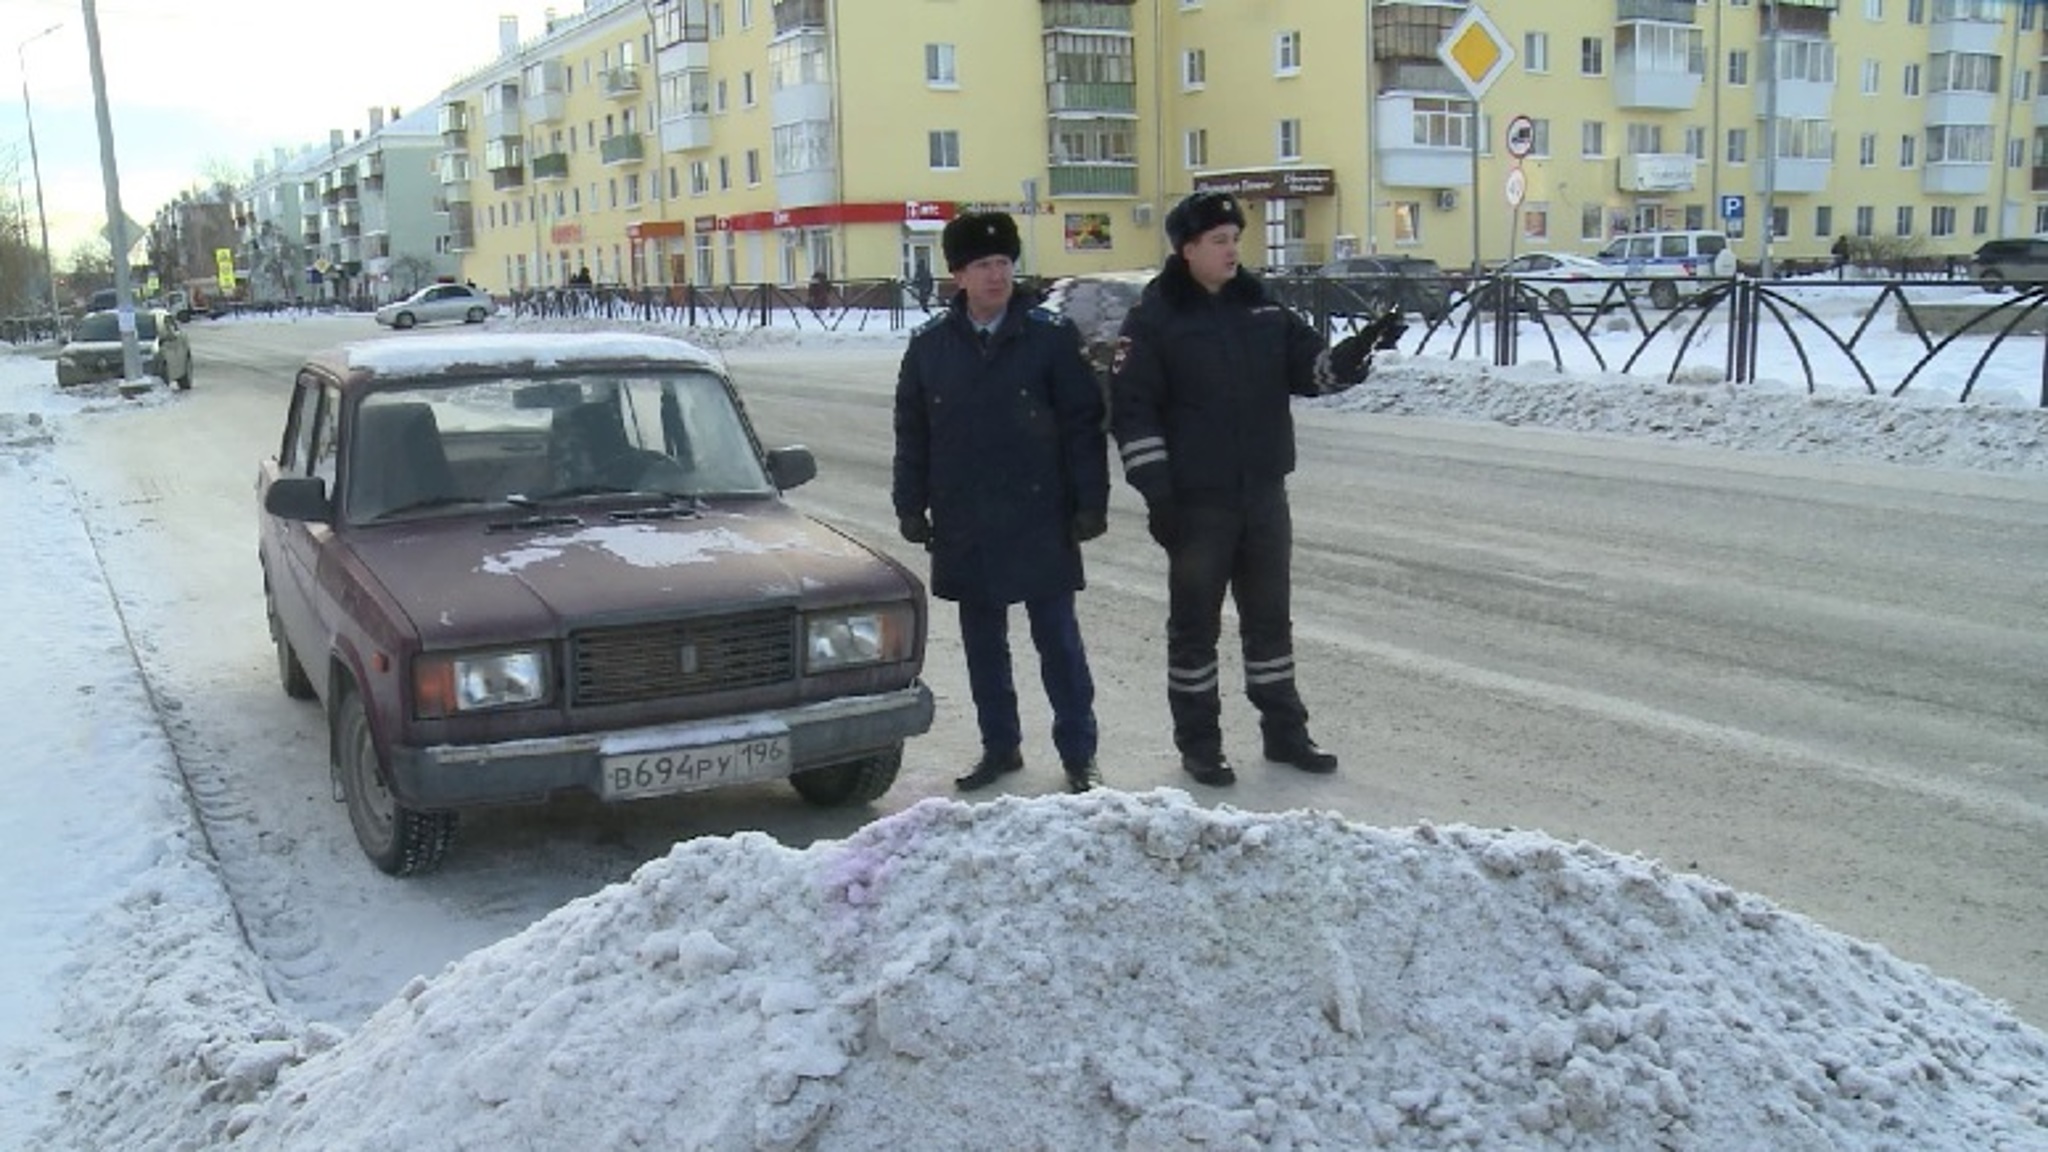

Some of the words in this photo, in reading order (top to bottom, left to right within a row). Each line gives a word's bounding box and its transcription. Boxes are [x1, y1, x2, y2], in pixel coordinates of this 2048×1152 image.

[1725, 198, 1741, 216] P
[615, 754, 732, 790] В694РУ
[741, 740, 783, 767] 196
